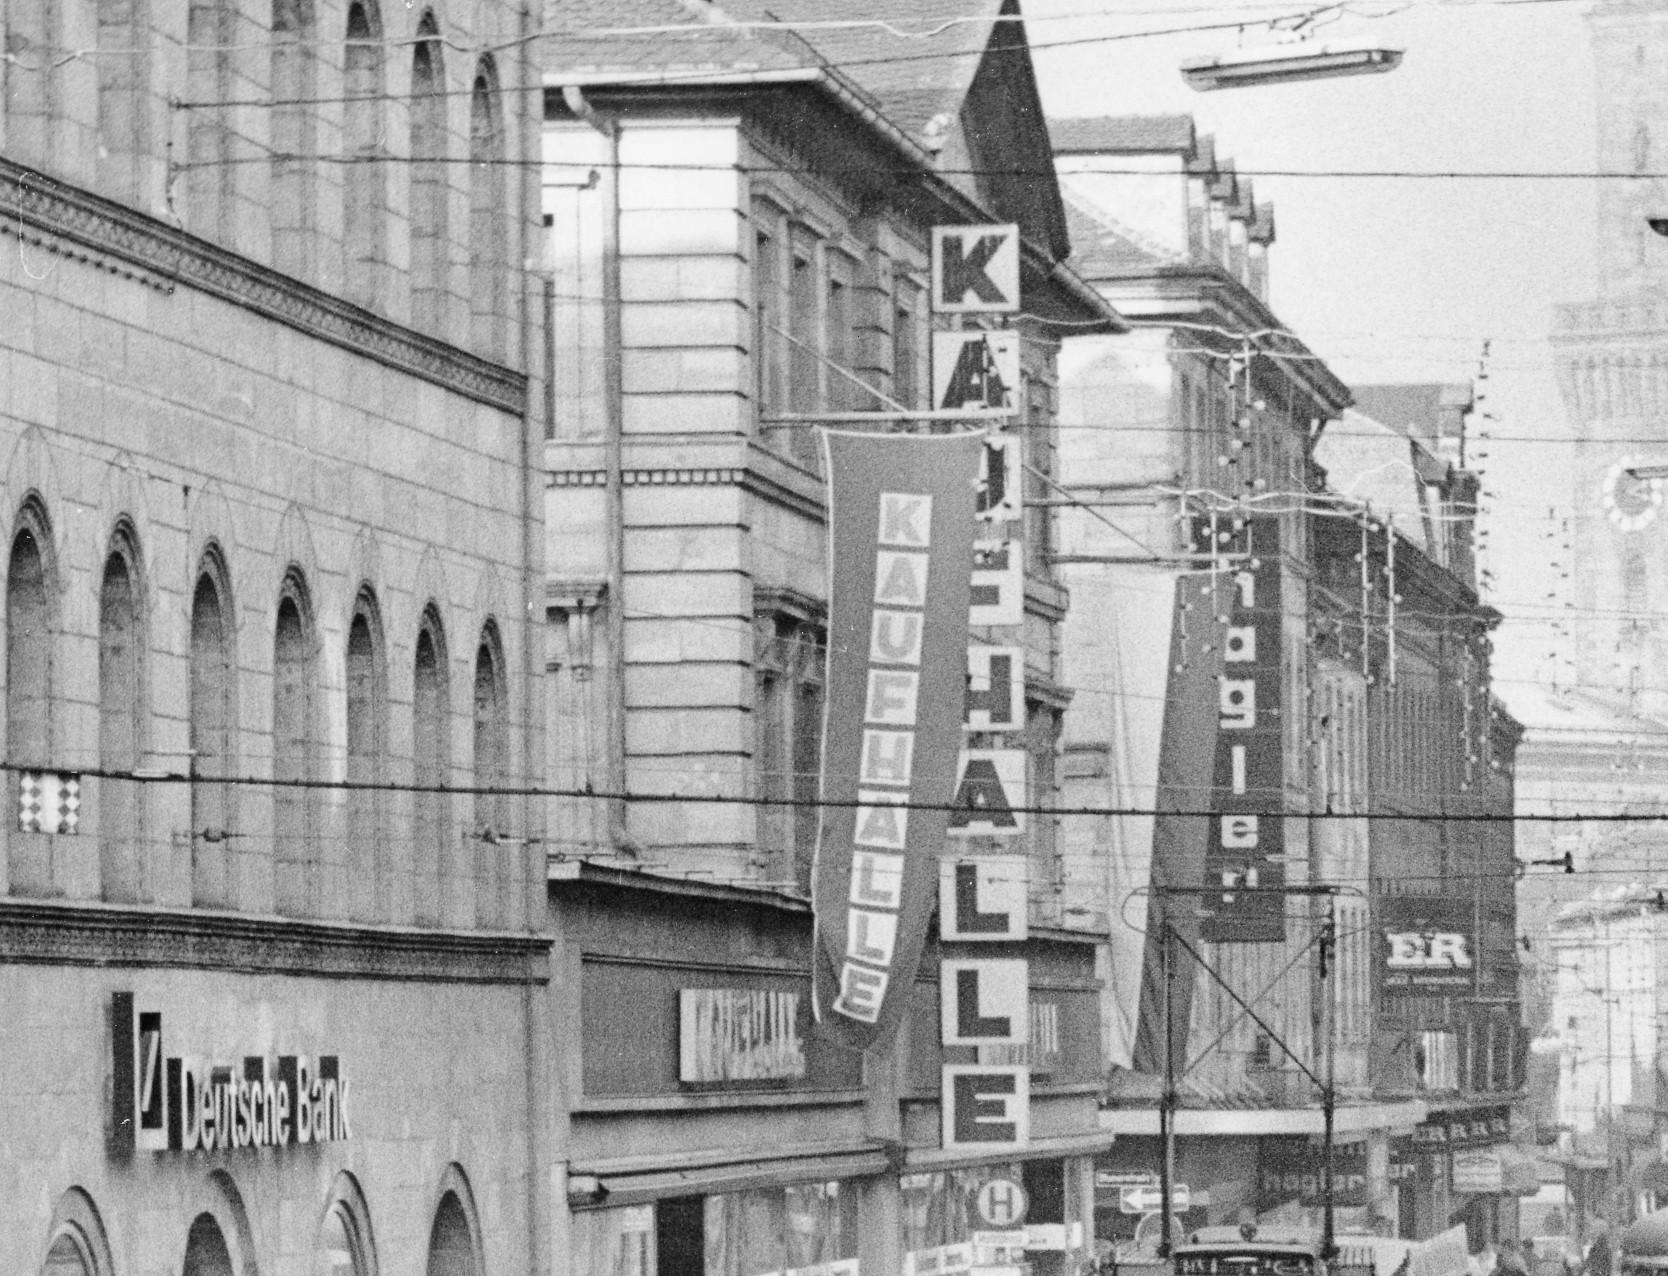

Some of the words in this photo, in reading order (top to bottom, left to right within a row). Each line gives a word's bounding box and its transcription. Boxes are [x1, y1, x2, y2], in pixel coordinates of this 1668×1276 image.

[844, 498, 927, 1017] KAUFHALLE
[181, 1056, 290, 1150] Deutsche
[297, 1056, 352, 1144] Bank
